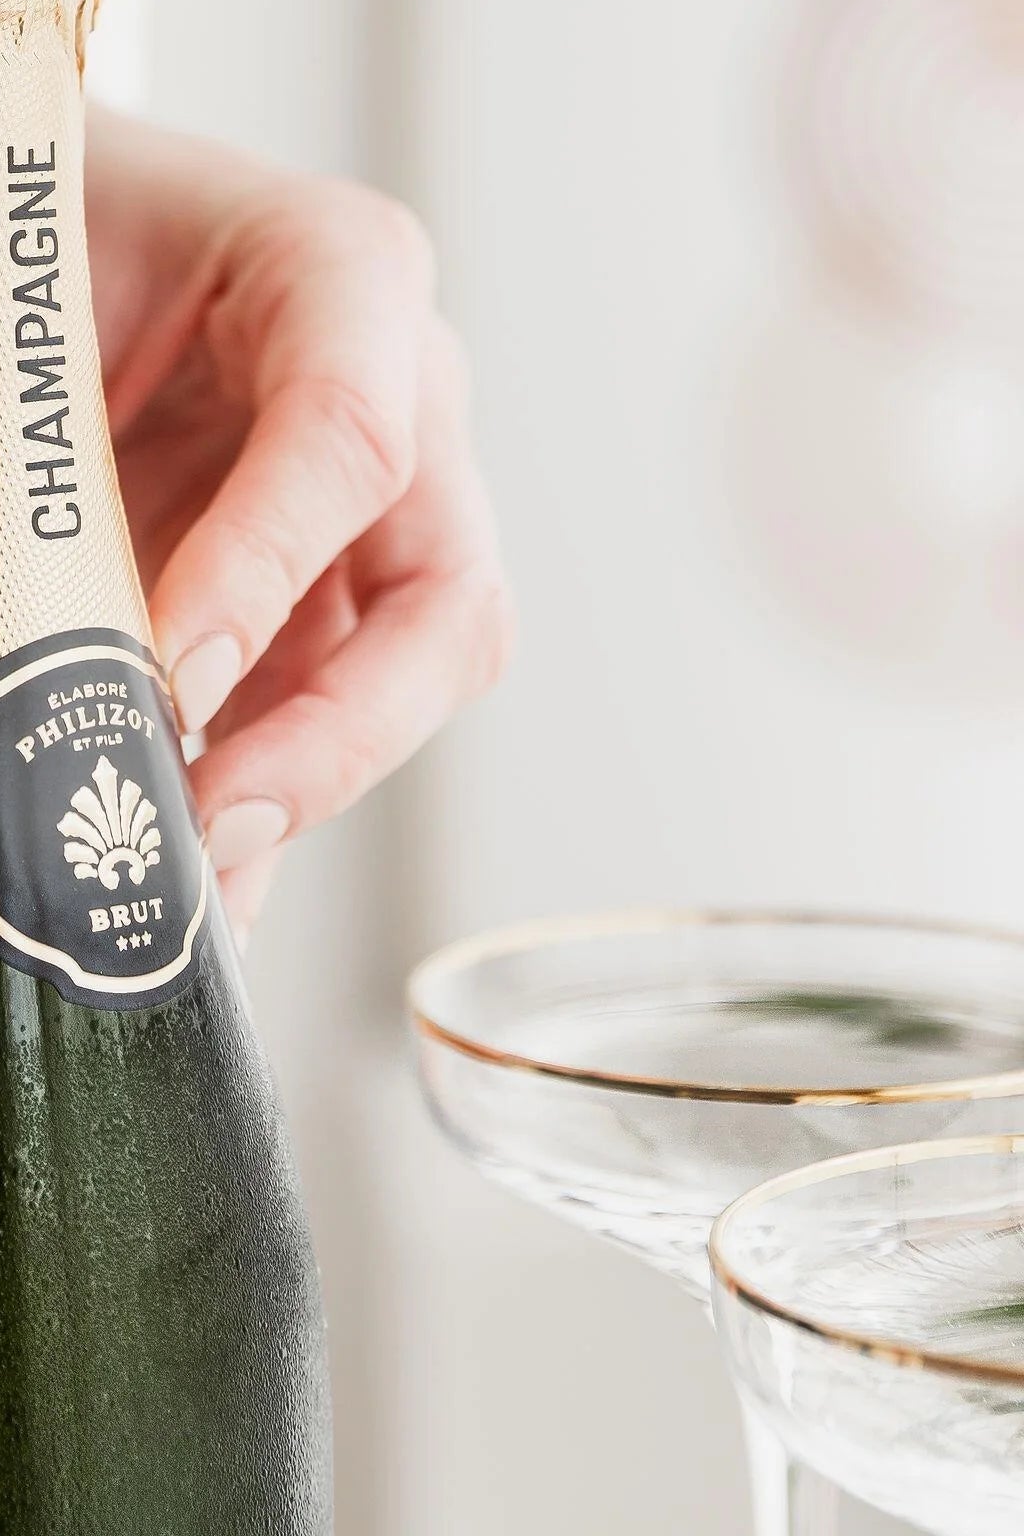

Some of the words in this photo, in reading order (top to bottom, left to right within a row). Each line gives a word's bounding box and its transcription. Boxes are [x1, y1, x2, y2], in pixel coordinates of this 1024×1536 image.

[7, 140, 82, 541] CHAMPAGNE
[47, 682, 128, 710] ÉLABORÉ
[15, 703, 156, 764] PHILIZOT
[72, 737, 91, 752] ET
[95, 732, 123, 747] FILS
[88, 898, 164, 933] BRUT
